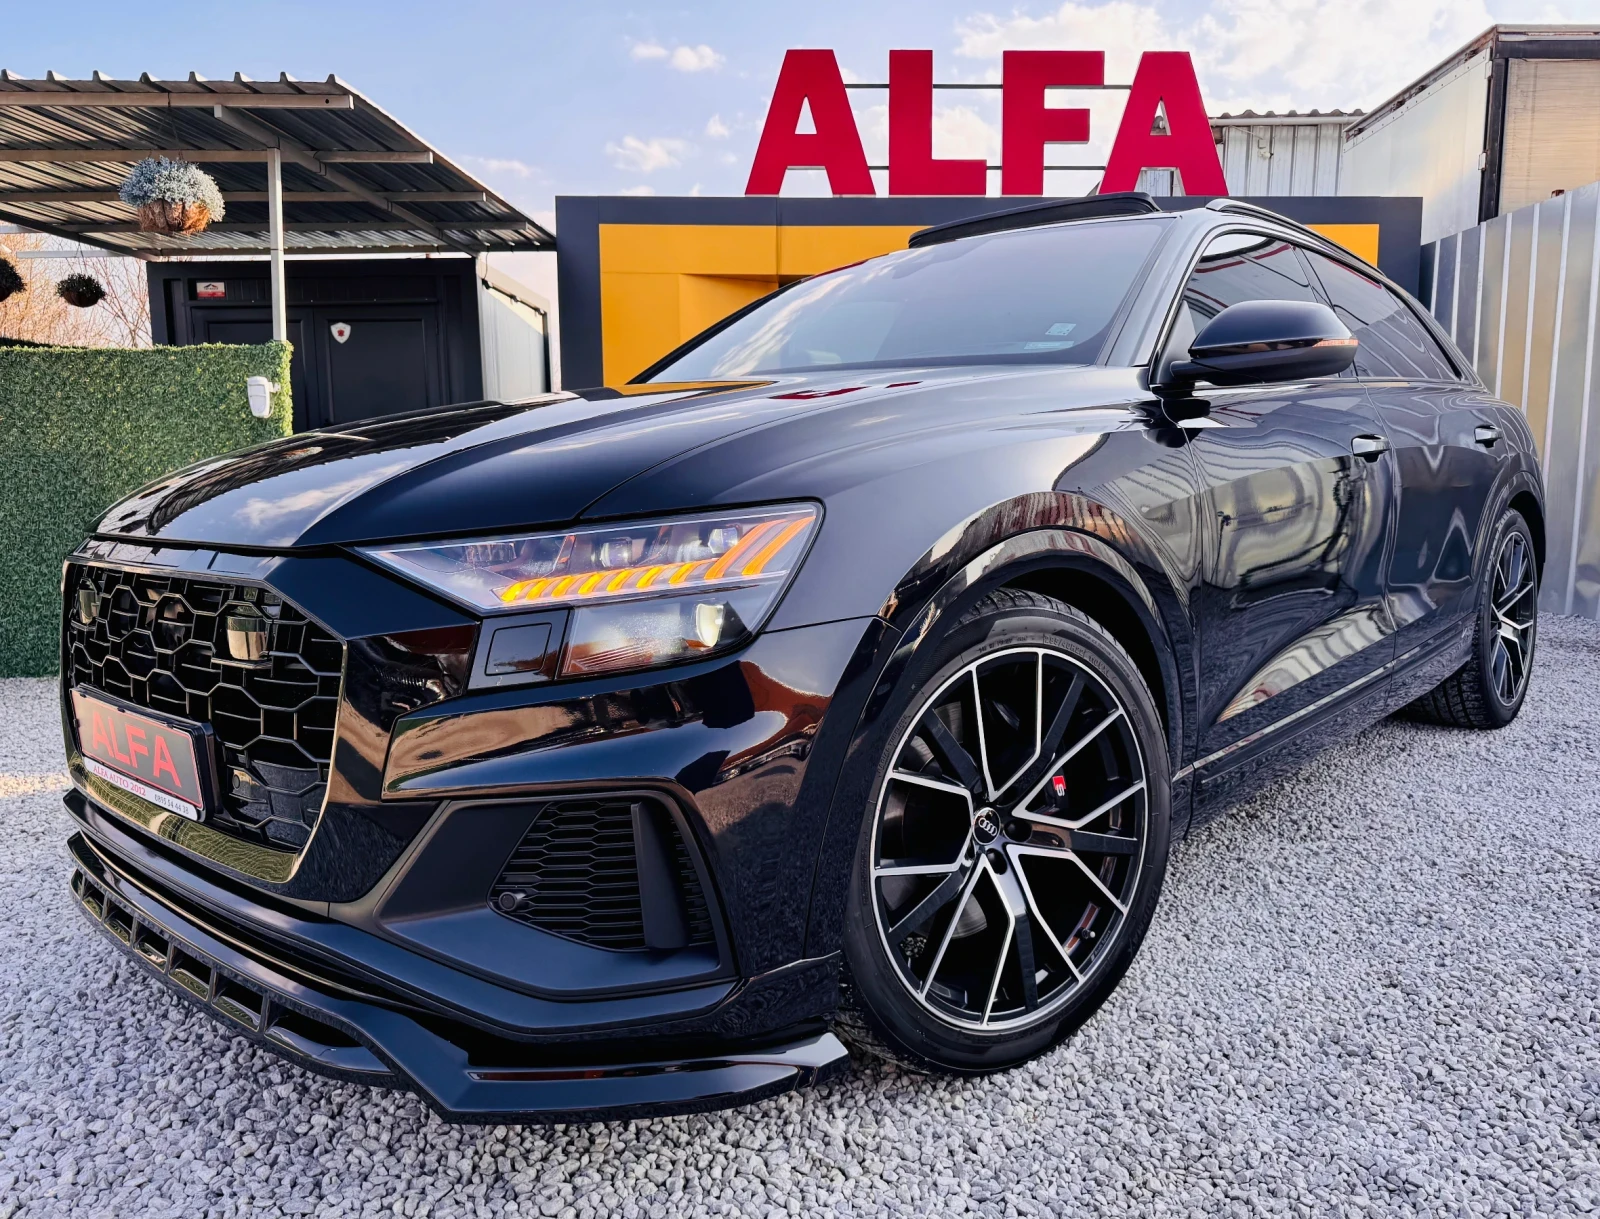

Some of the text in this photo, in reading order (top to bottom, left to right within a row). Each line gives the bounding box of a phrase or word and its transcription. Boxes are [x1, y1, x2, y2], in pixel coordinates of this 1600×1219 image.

[744, 48, 1229, 196] ALFA
[92, 711, 182, 789] ALFA
[93, 764, 109, 780] ALFA
[109, 773, 129, 789] AUTO
[130, 783, 147, 797] 2012
